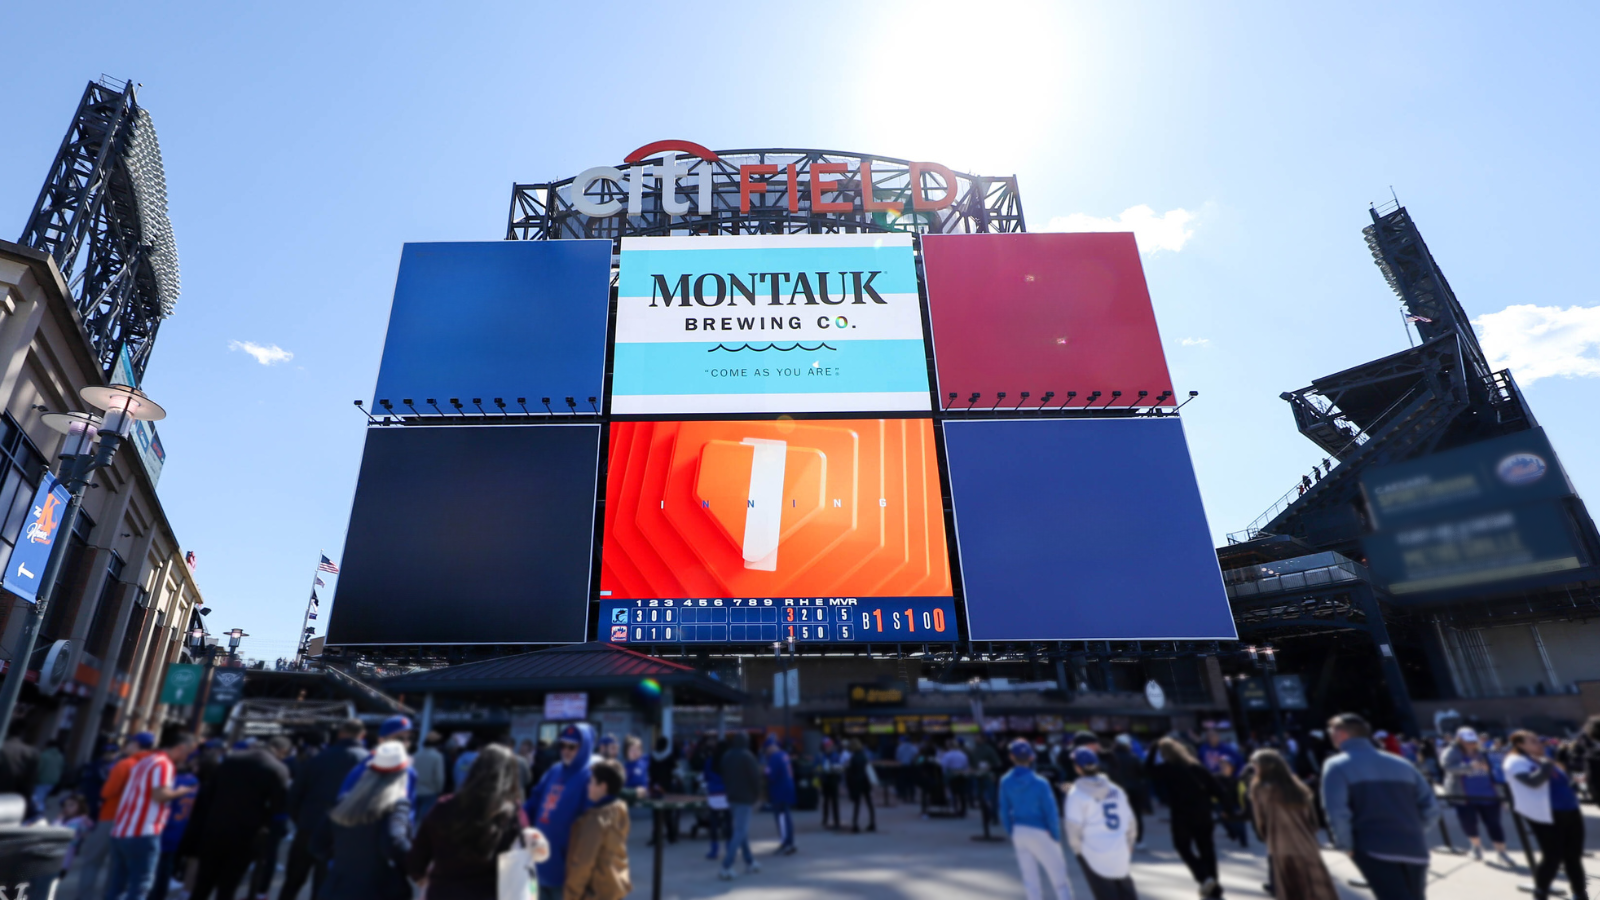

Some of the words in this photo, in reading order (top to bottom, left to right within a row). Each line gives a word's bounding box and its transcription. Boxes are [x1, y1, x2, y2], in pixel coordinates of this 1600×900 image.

[571, 140, 718, 217] citi
[740, 161, 958, 214] FIELD
[648, 271, 888, 307] MONTAUK
[685, 316, 802, 331] BREWING
[817, 315, 856, 329] CO.
[754, 368, 770, 377] AS
[776, 368, 801, 377] YOU
[829, 598, 857, 606] MVR
[636, 610, 642, 622] 3
[651, 610, 657, 622] 0
[666, 610, 672, 622] 0
[787, 608, 794, 622] 3
[801, 608, 807, 620] 2
[817, 608, 823, 620] 0
[841, 608, 847, 620] 5
[636, 627, 642, 639] 0
[651, 628, 656, 639] 1
[666, 627, 671, 639] 0
[787, 626, 793, 637] 1
[803, 626, 808, 638] 5
[817, 626, 824, 638] 0
[842, 626, 848, 638] 5
[1103, 803, 1120, 831] 5
